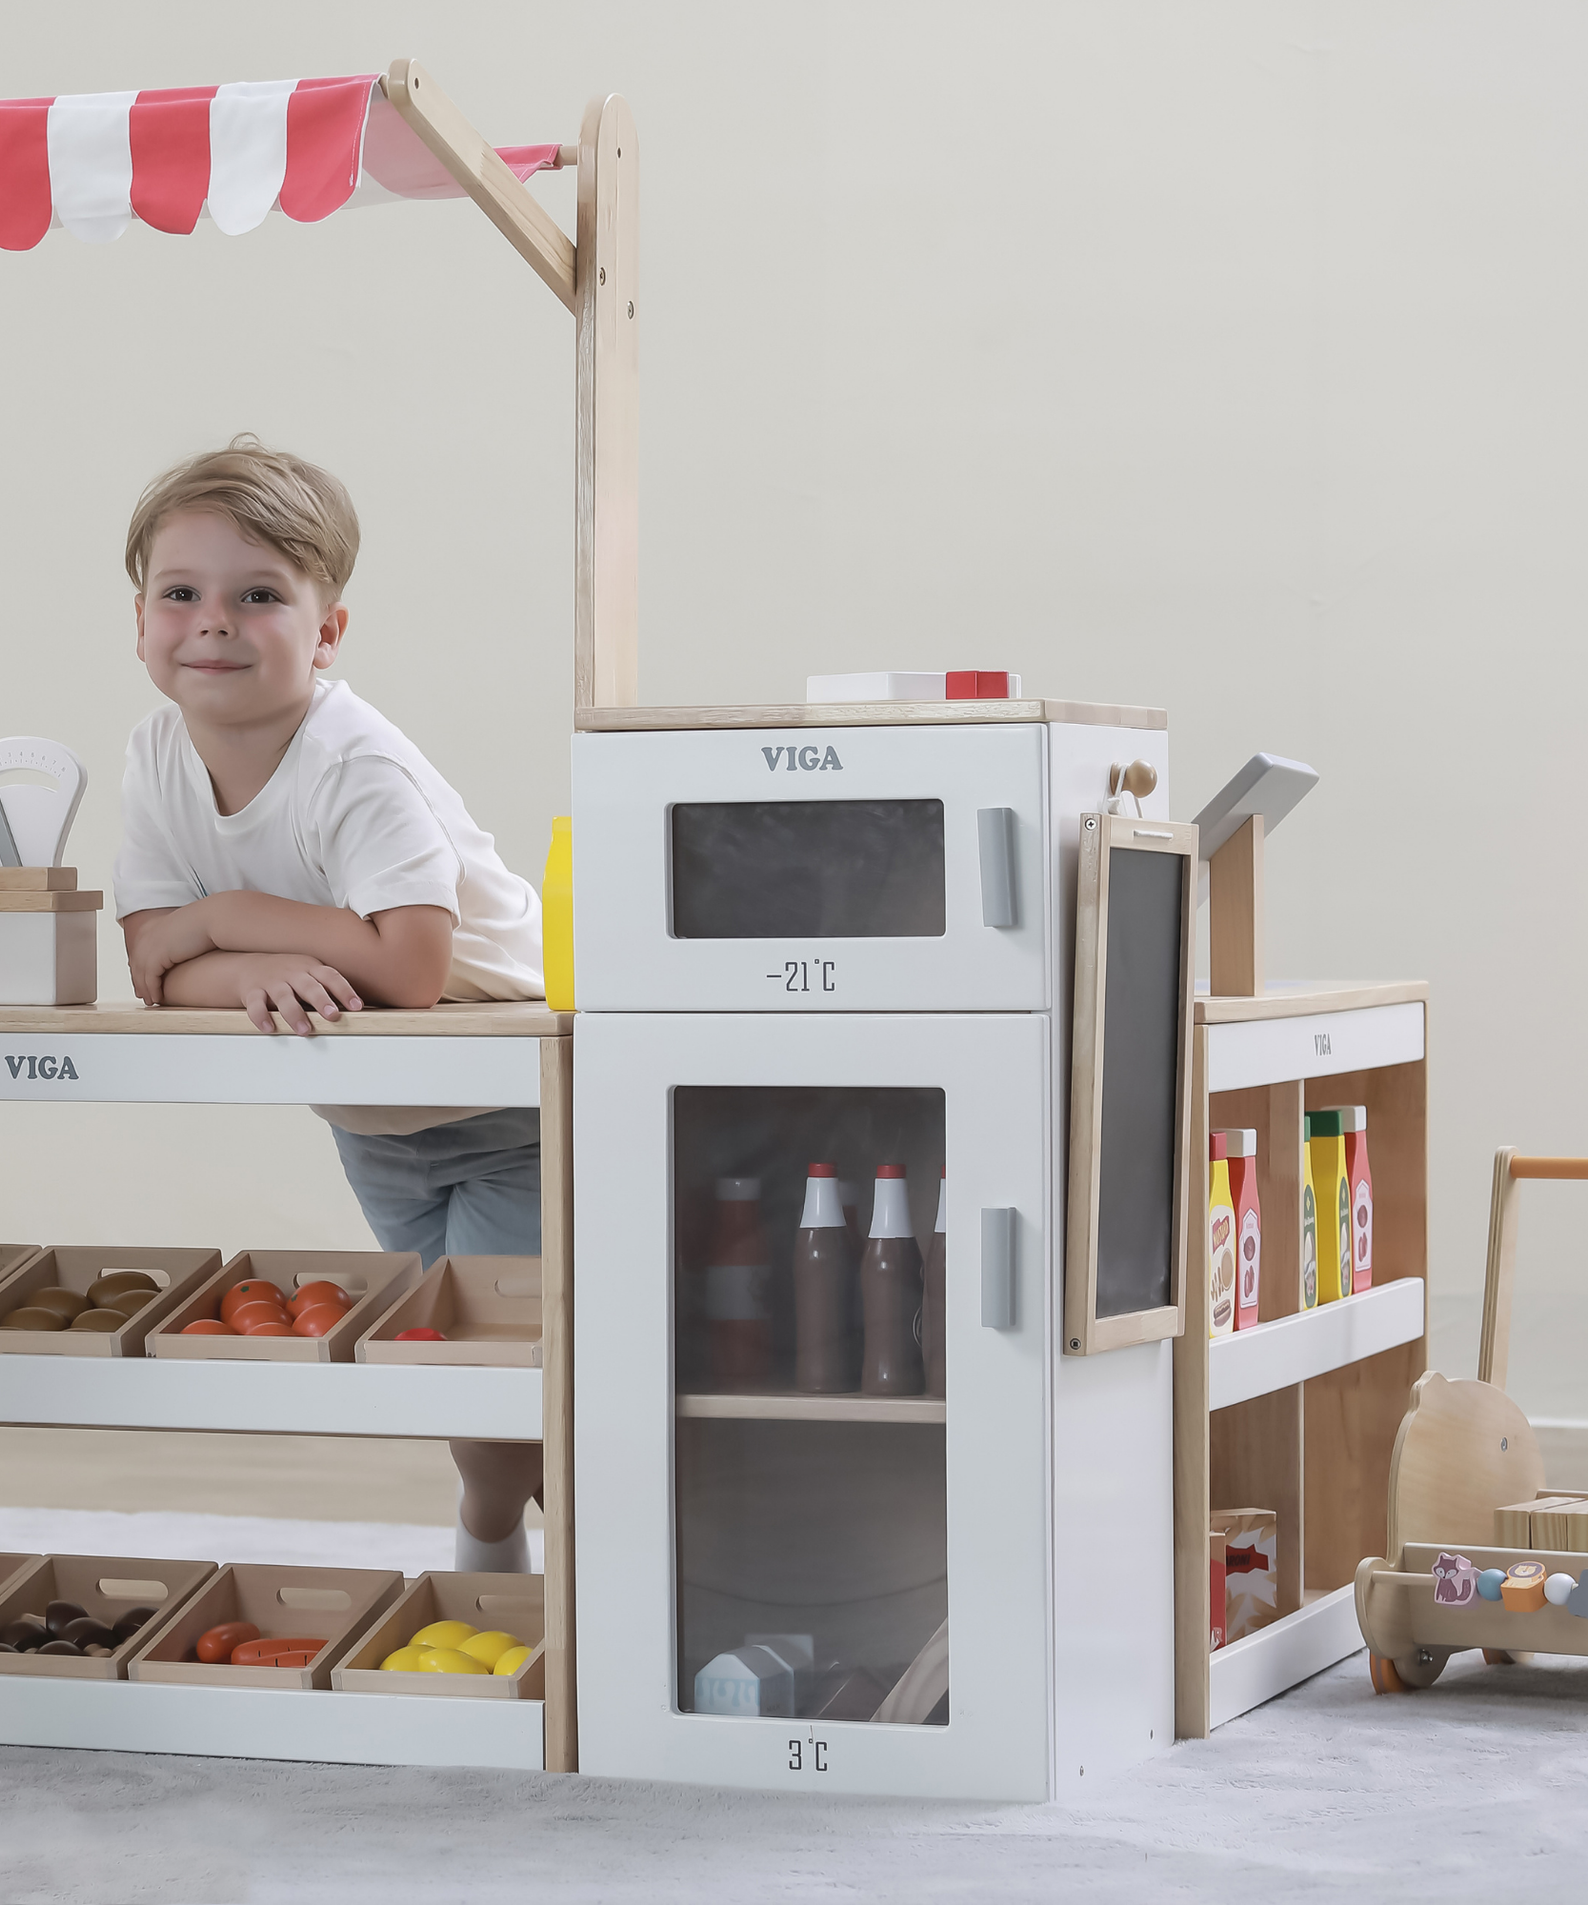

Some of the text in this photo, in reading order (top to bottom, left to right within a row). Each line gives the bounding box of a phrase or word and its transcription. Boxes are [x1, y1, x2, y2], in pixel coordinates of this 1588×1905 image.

[760, 745, 844, 772] VIGA
[1314, 1033, 1332, 1056] VIGA
[4, 1055, 80, 1080] VIGA
